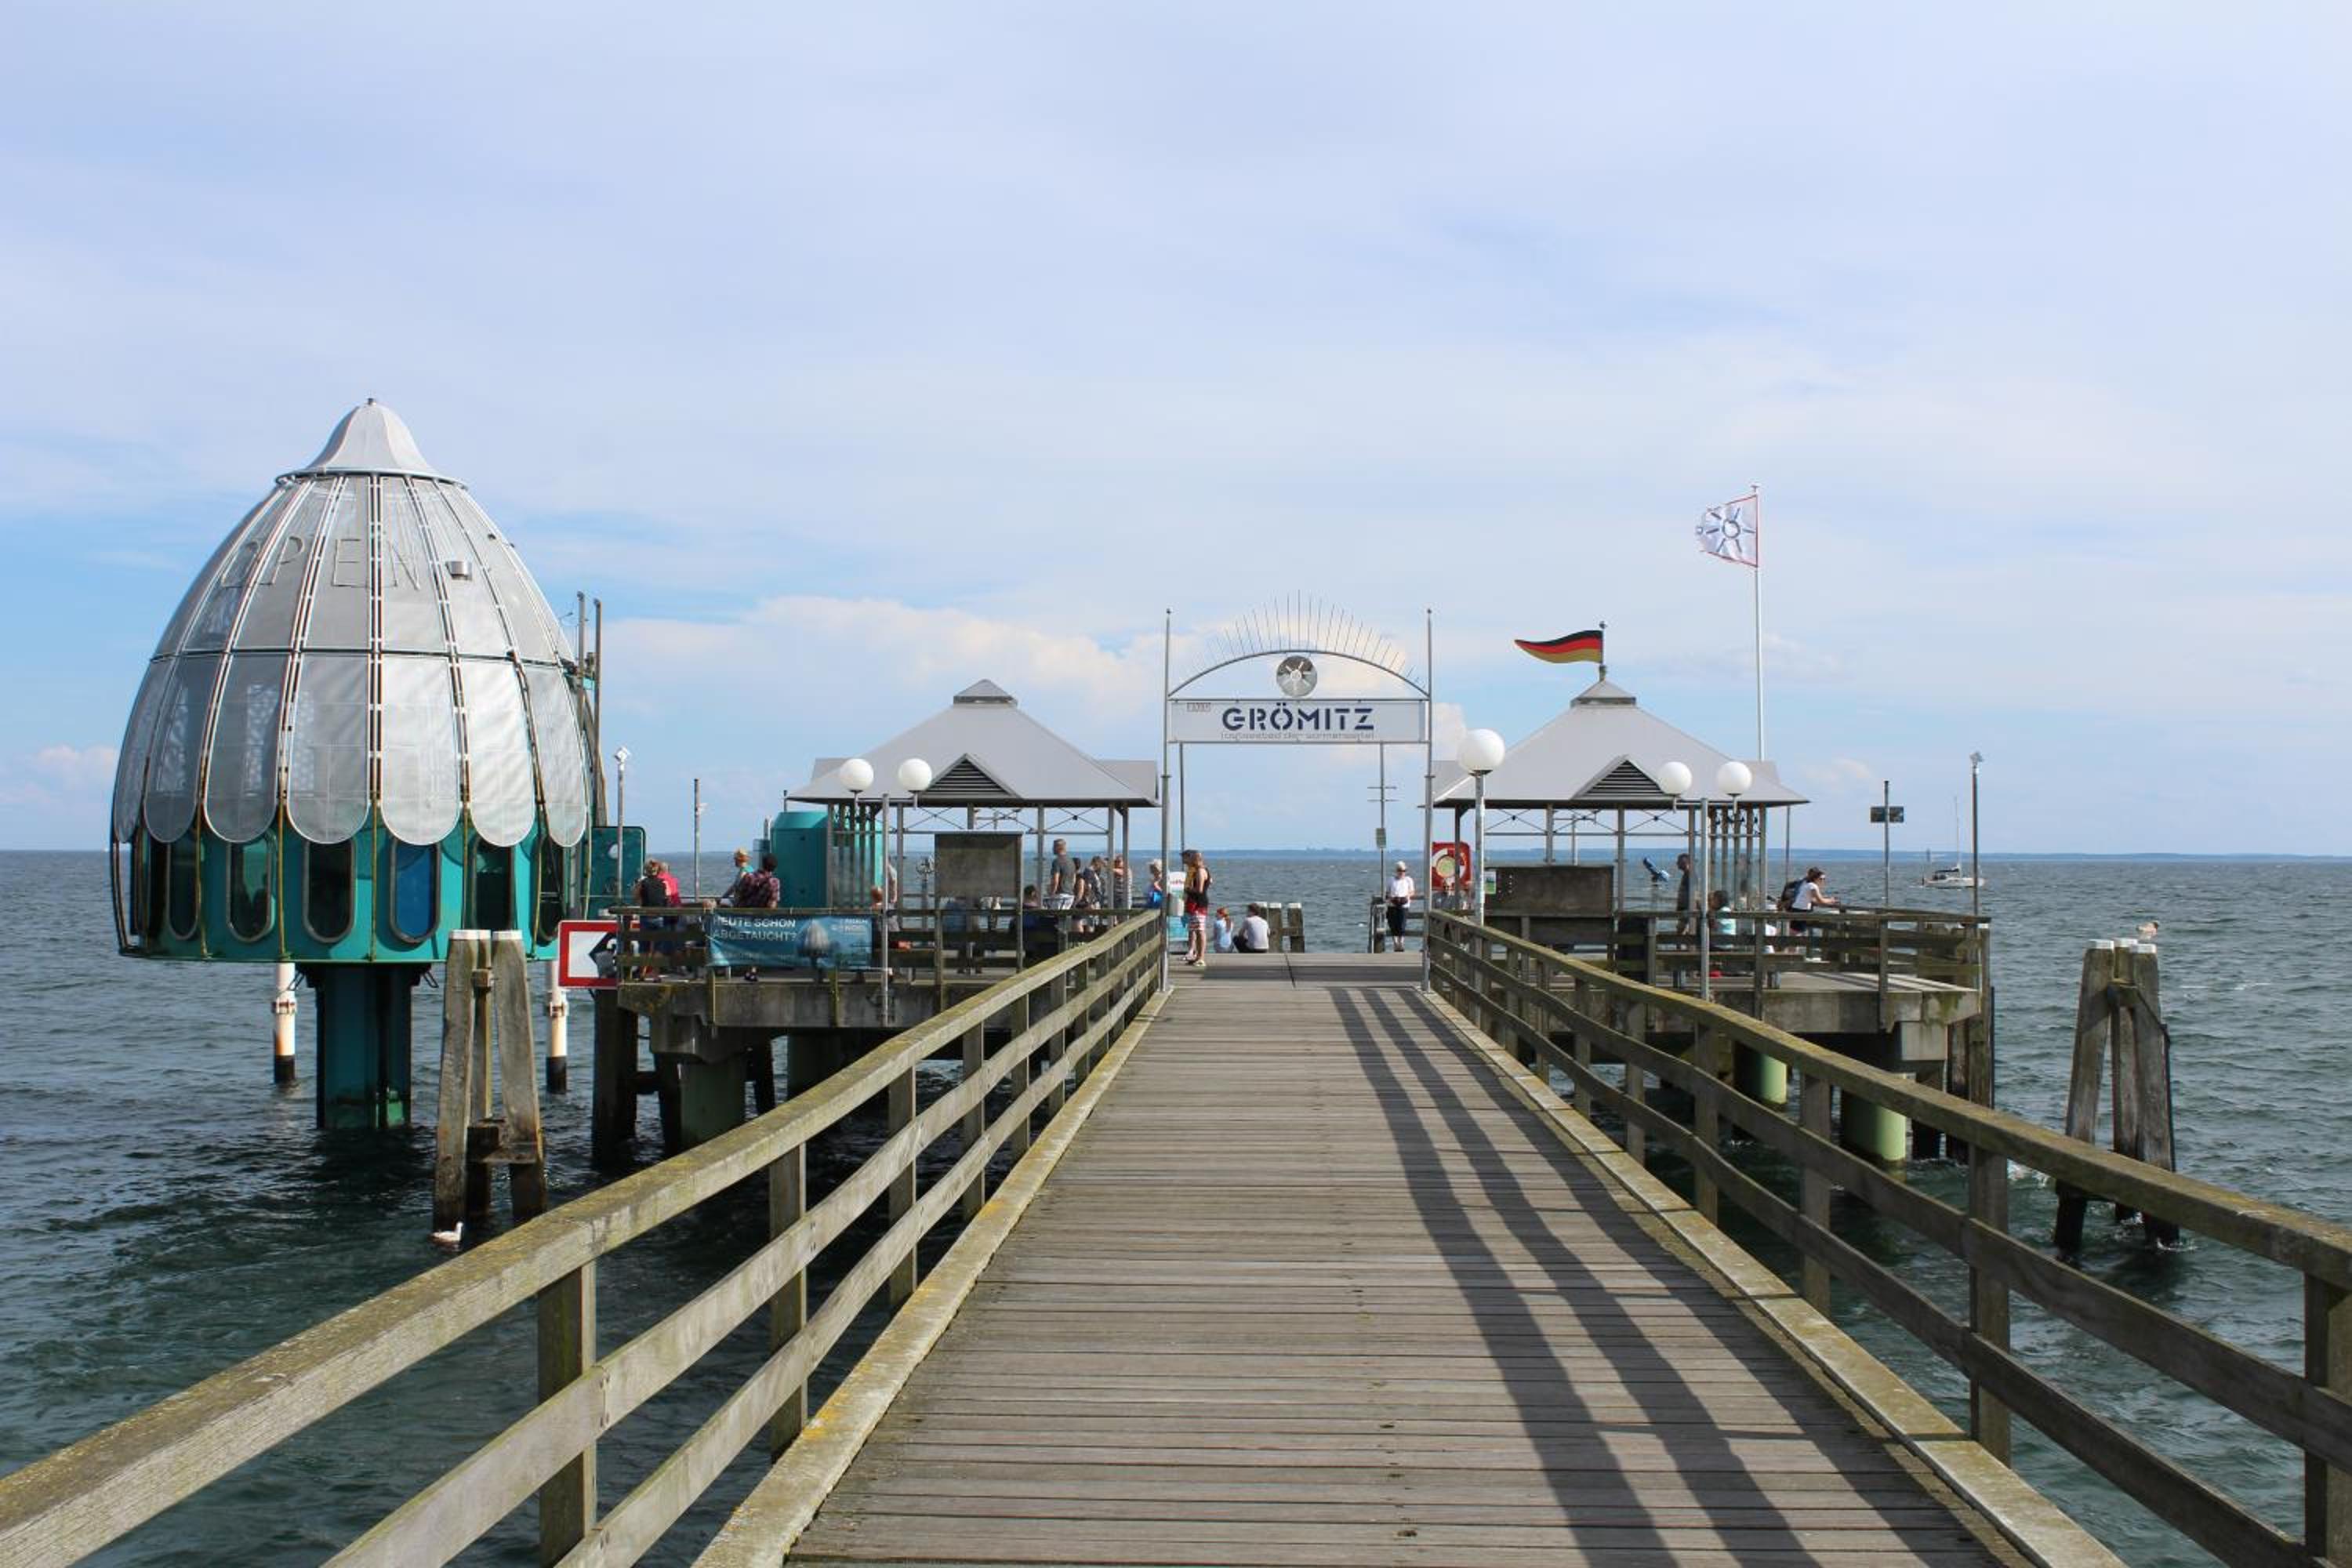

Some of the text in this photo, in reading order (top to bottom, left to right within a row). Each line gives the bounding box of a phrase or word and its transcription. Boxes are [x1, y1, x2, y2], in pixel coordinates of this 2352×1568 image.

[1221, 702, 1374, 731] GRÖMITZ
[713, 916, 796, 928] HEUTE SCHON
[712, 929, 797, 942] ABGETAUCHT?
